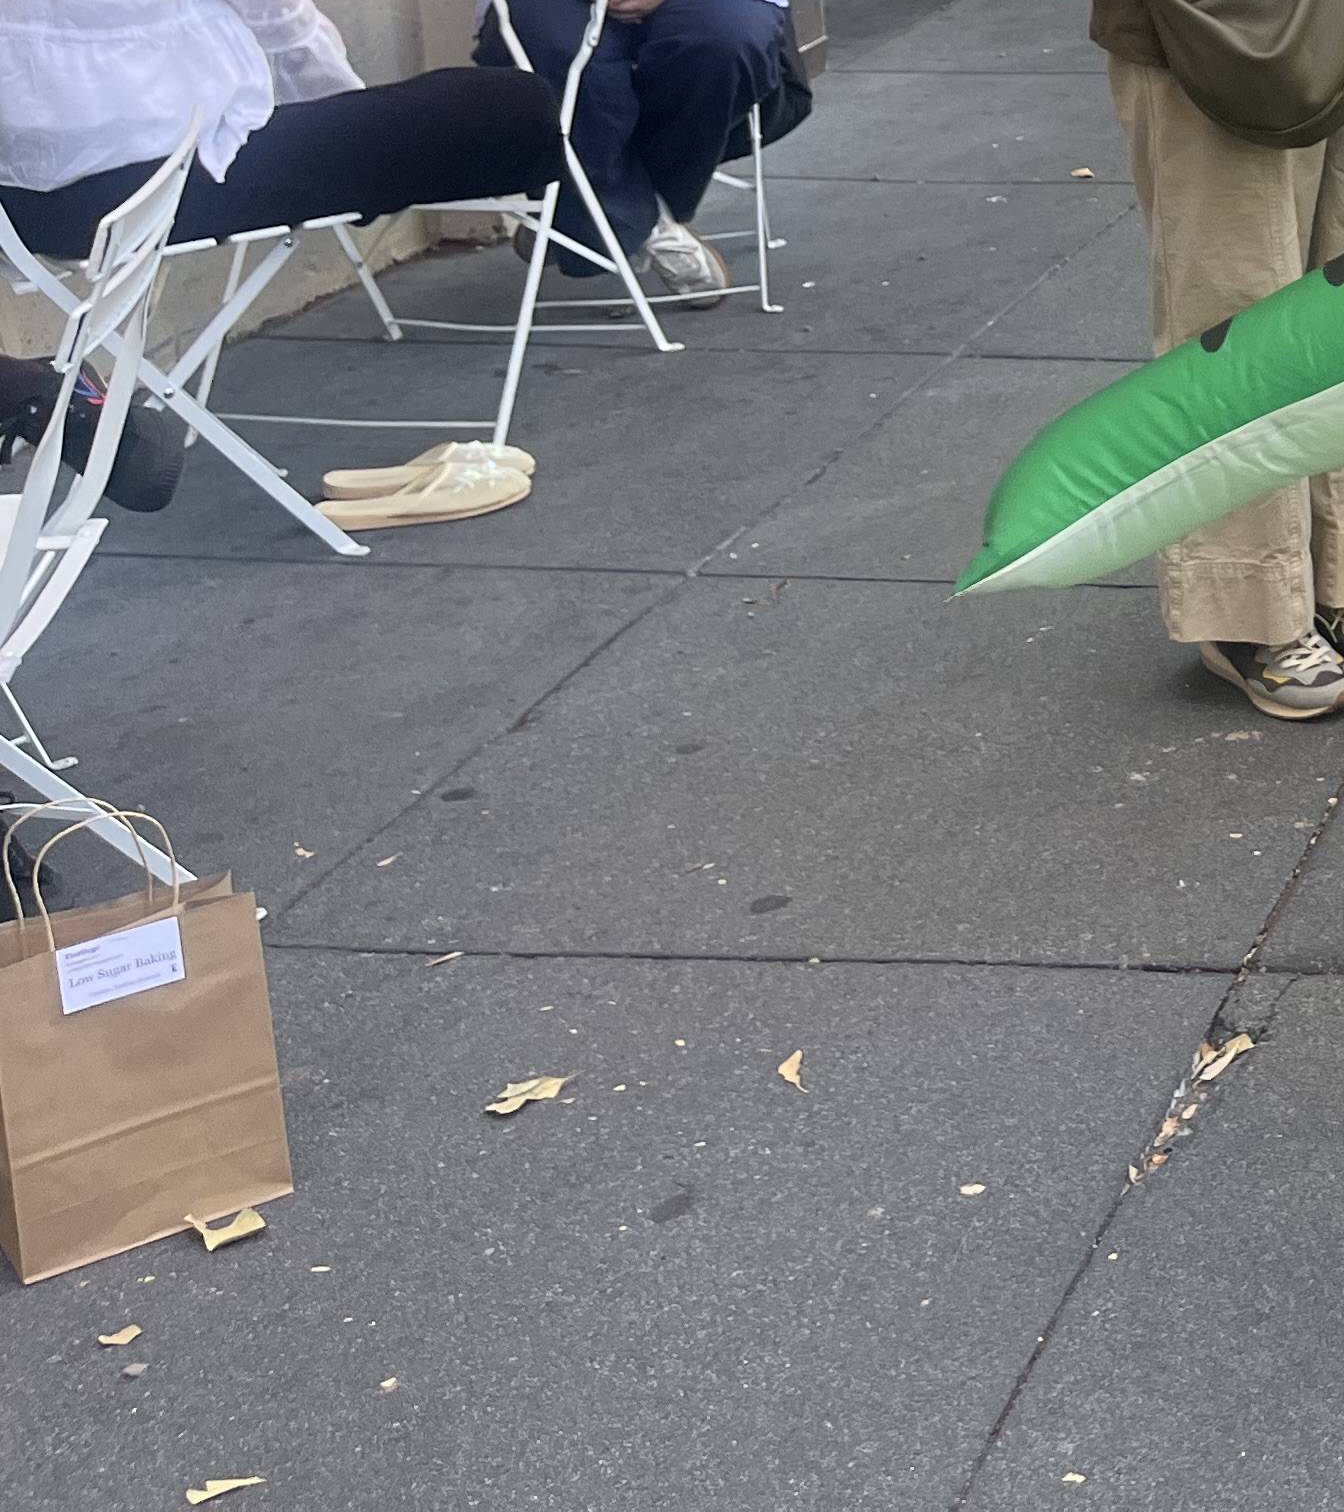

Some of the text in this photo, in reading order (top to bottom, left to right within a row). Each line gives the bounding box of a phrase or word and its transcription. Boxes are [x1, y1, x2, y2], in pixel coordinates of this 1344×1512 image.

[68, 974, 95, 989] Low
[97, 962, 133, 979] Sugar
[135, 950, 178, 969] Baking
